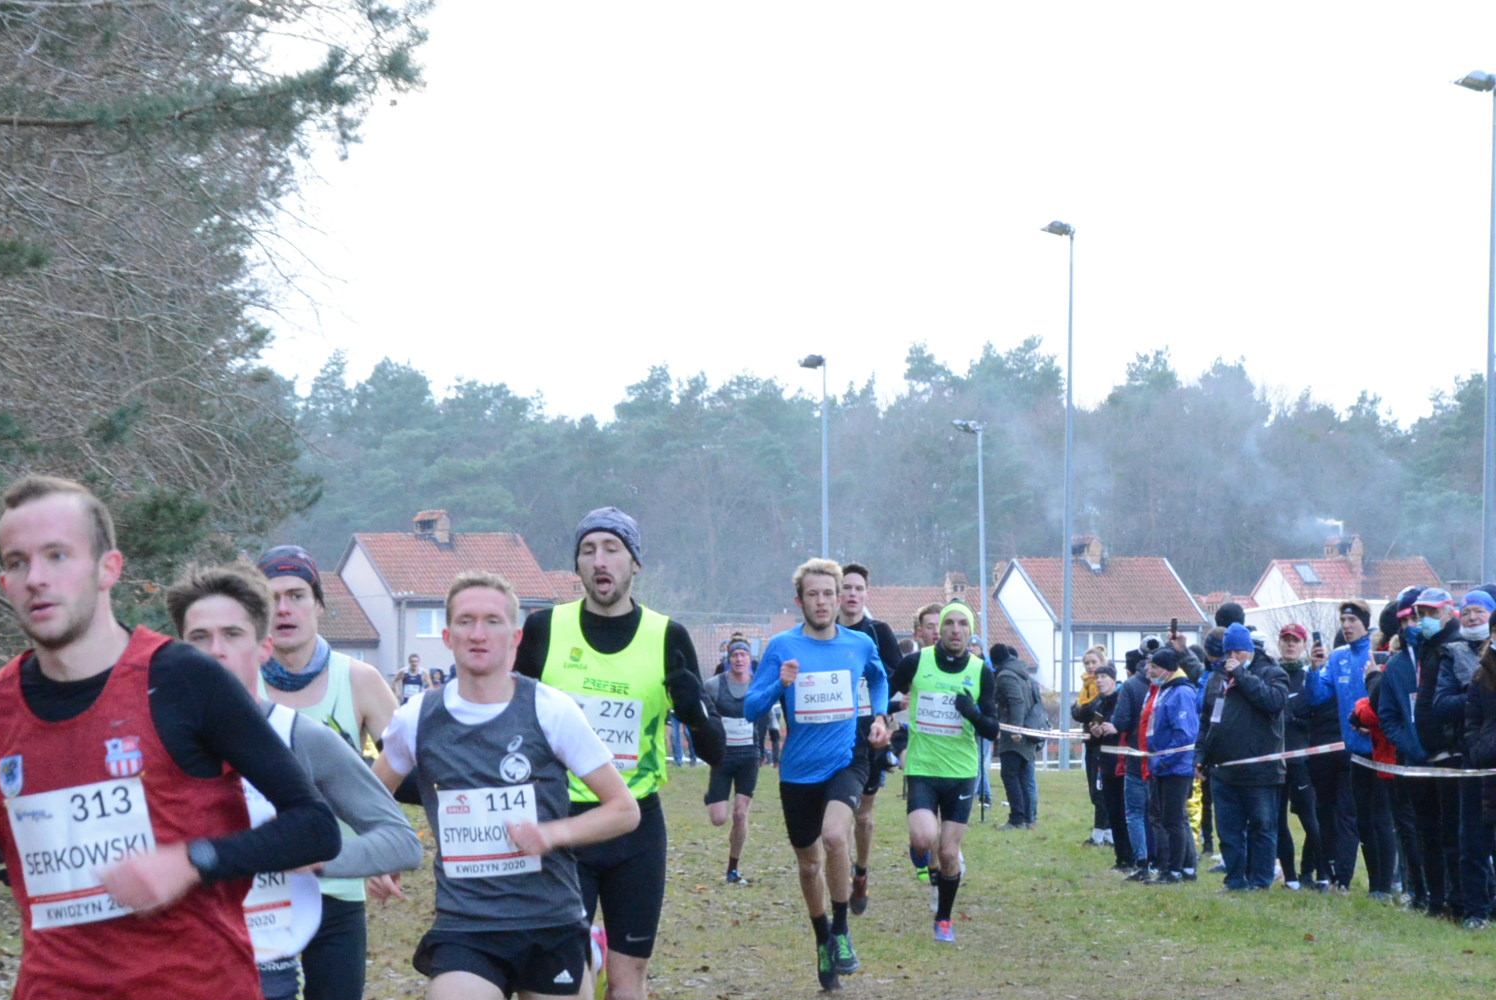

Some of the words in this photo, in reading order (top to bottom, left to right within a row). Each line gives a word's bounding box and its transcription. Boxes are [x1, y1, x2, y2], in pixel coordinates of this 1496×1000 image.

[830, 672, 839, 685] 8
[804, 692, 843, 704] SKIBIAK
[599, 700, 635, 719] 276
[69, 785, 133, 822] 313
[485, 789, 527, 812] 114
[24, 833, 148, 876] SERKOWSKI
[455, 863, 500, 874] KWIDZYN
[502, 859, 526, 871] 2020
[45, 899, 103, 921] KWIDZYN
